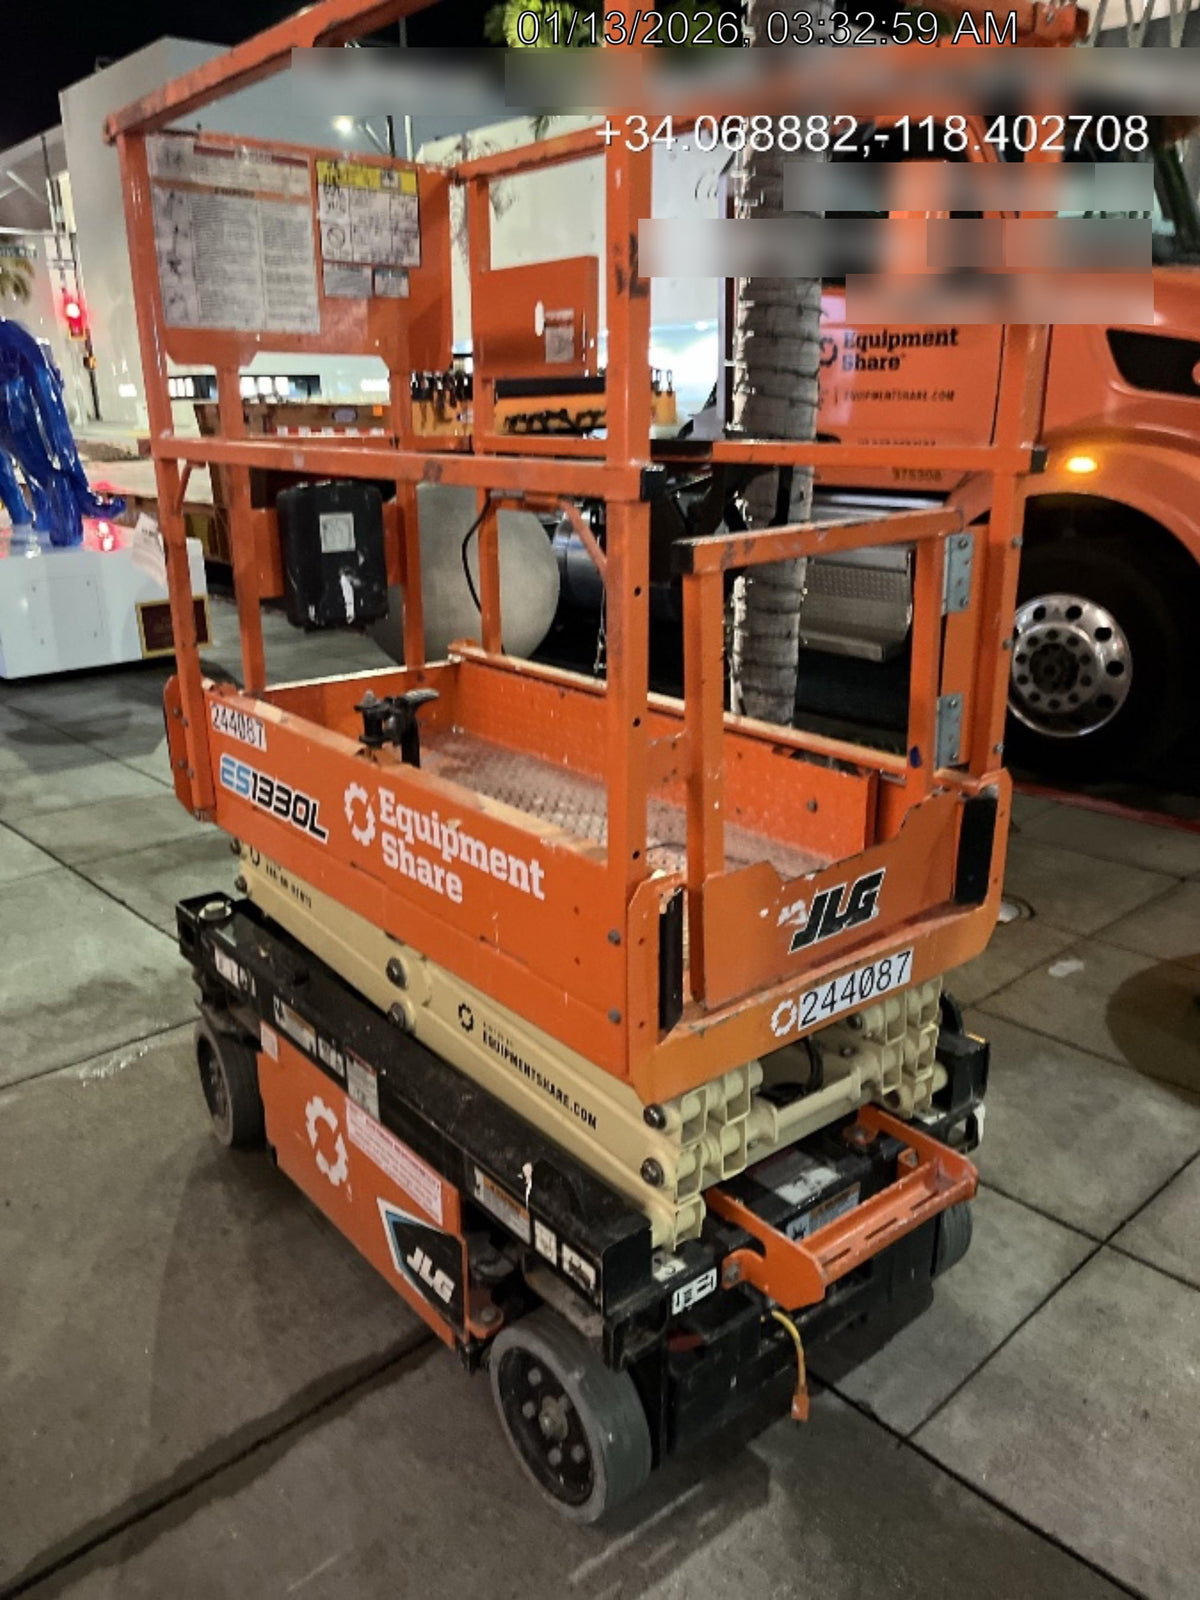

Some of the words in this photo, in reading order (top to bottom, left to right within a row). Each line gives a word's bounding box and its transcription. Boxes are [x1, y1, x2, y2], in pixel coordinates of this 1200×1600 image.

[842, 353, 901, 372] Share
[844, 327, 959, 353] Equipment
[211, 702, 264, 748] 244087
[221, 755, 328, 841] ES1330L
[377, 786, 546, 901] Equipment
[382, 831, 464, 905] Share
[788, 868, 886, 953] JLG
[801, 950, 912, 1028] 244087
[406, 1246, 456, 1304] JLG
